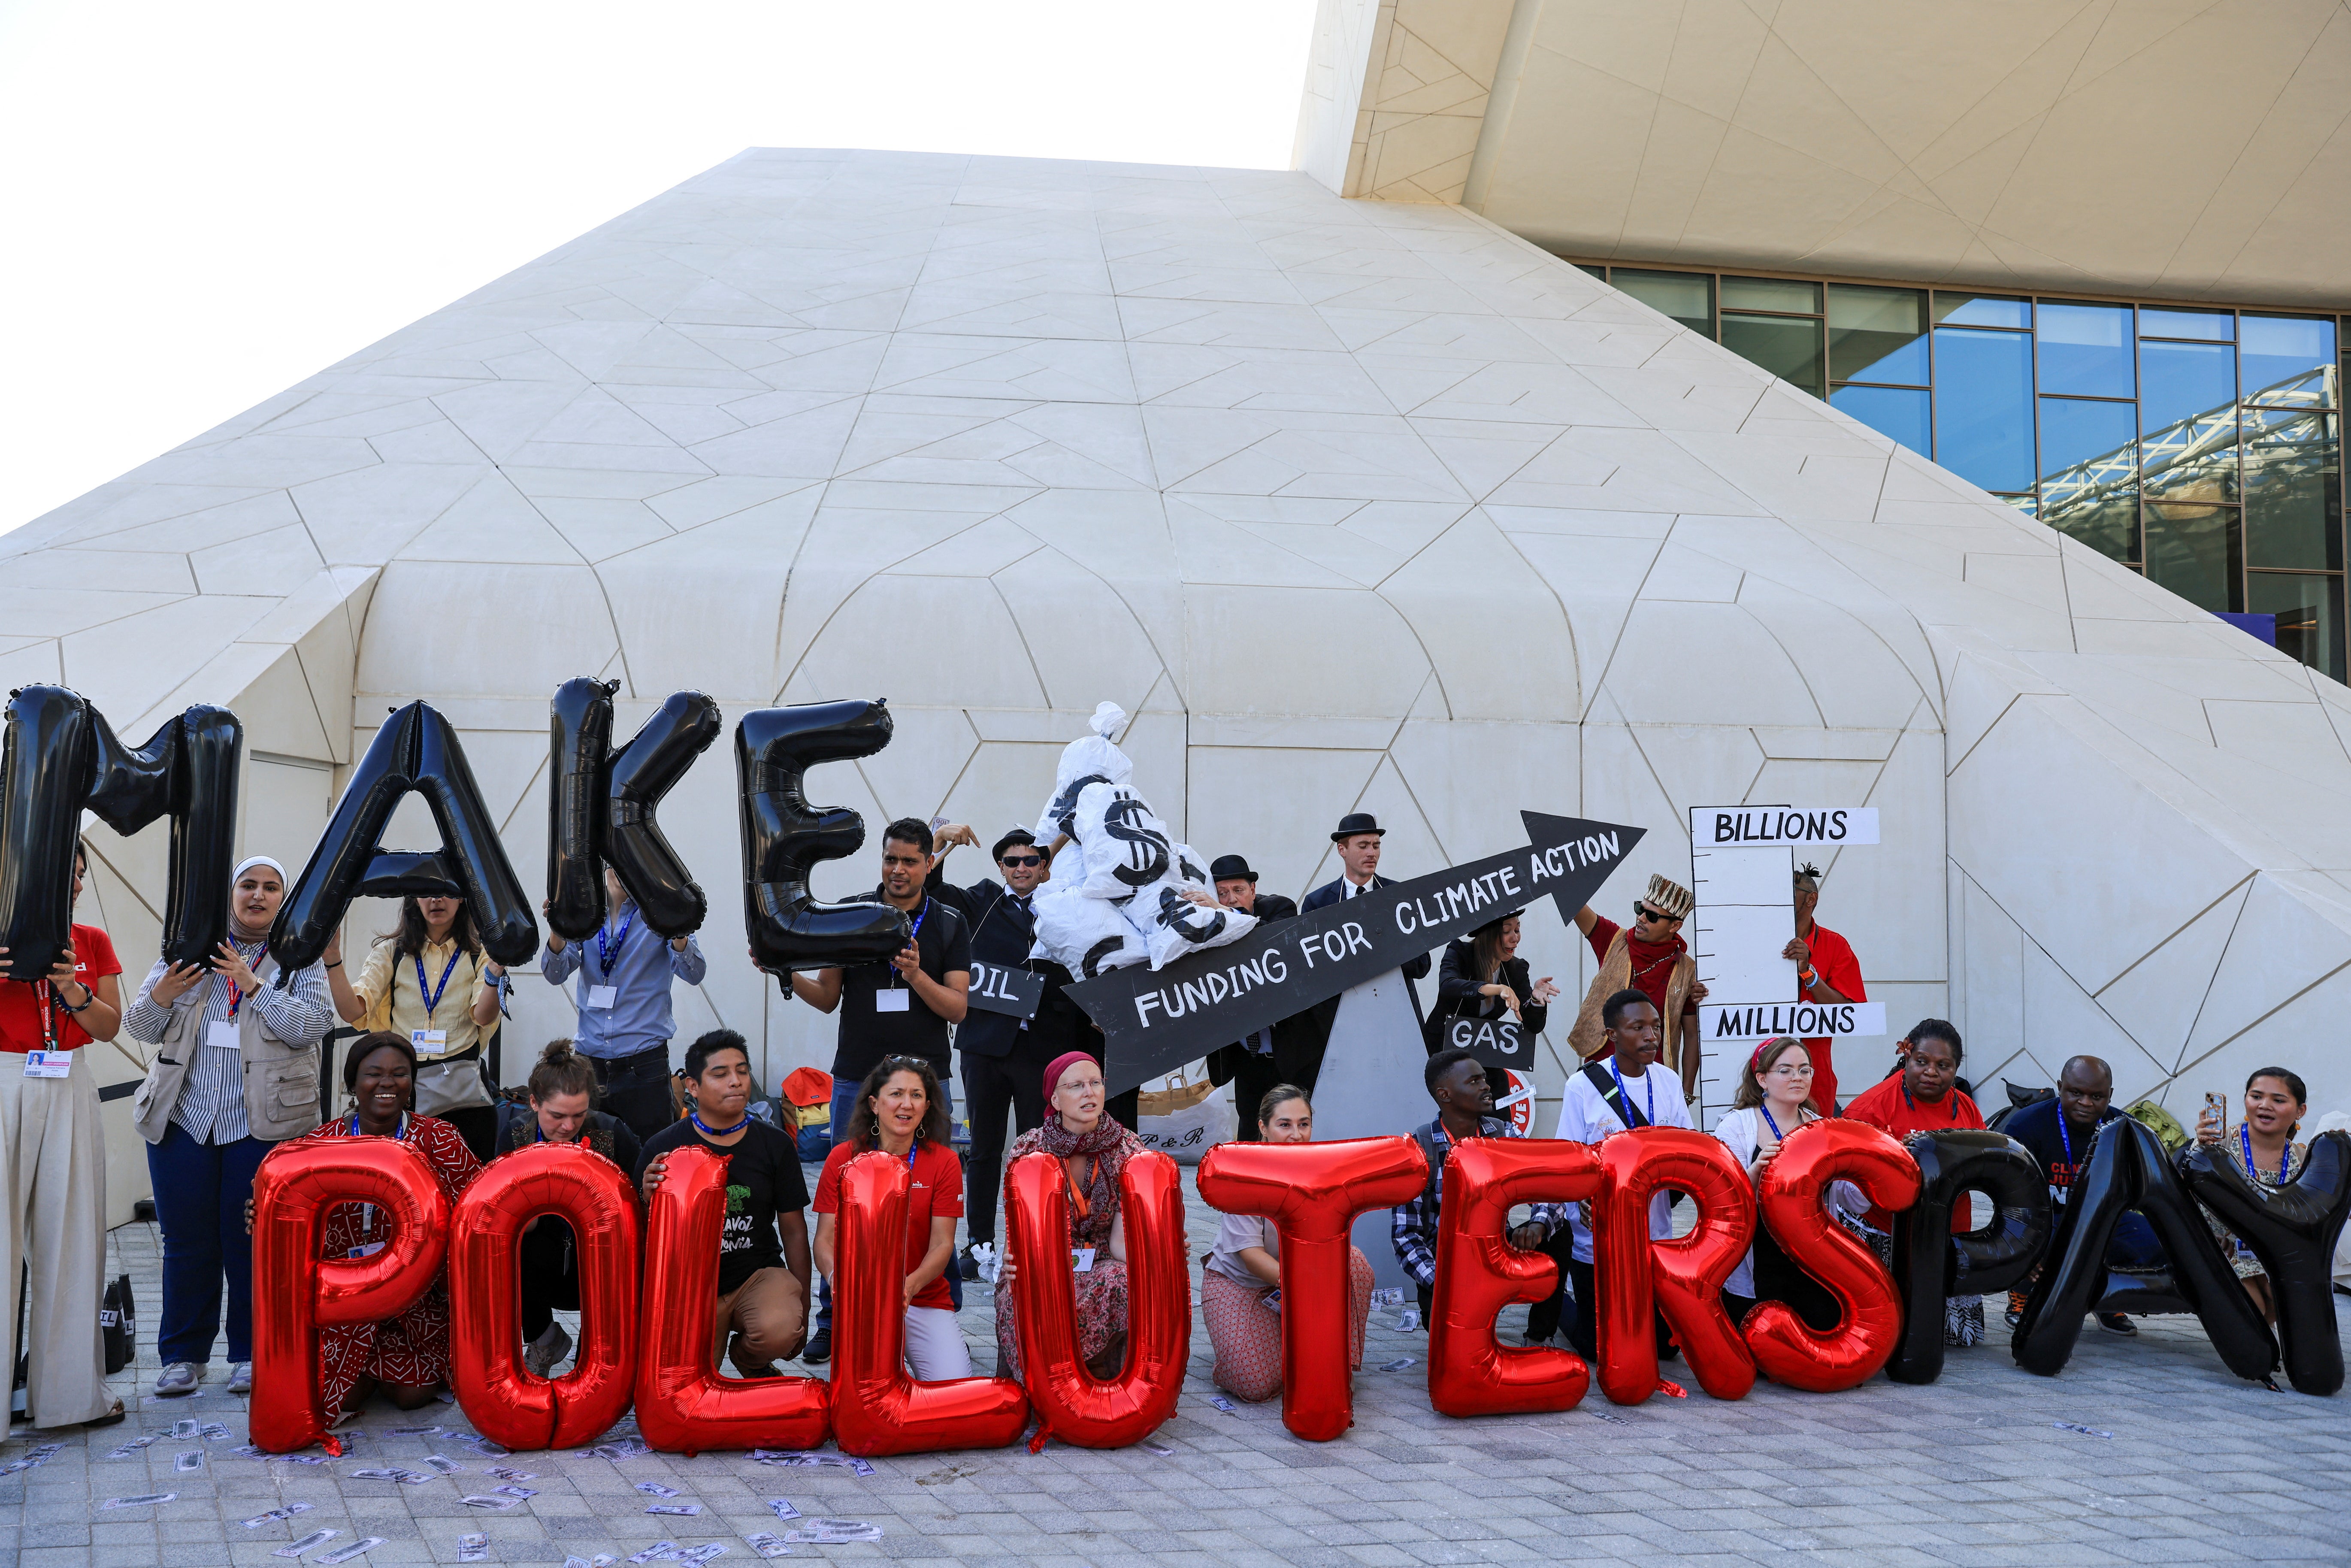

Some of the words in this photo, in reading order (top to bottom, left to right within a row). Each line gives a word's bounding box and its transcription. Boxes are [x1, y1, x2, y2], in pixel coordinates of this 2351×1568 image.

[0, 675, 913, 999] MAKE
[1715, 810, 1848, 842] BILLIONS
[1134, 948, 1287, 1028] FUNDING
[1299, 922, 1374, 969] FOR
[1395, 866, 1522, 935] CLIMATE
[1531, 830, 1620, 884] ACTION
[968, 963, 1019, 1001] OIL
[1452, 1020, 1519, 1054] GAS
[1716, 1006, 1855, 1037] MILLIONS
[1161, 1138, 1177, 1147] &
[1180, 1126, 1204, 1147] R
[251, 1118, 1921, 1456] POLLUTERS
[1885, 1114, 2351, 1395] PAY
[808, 1520, 820, 1528] 100
